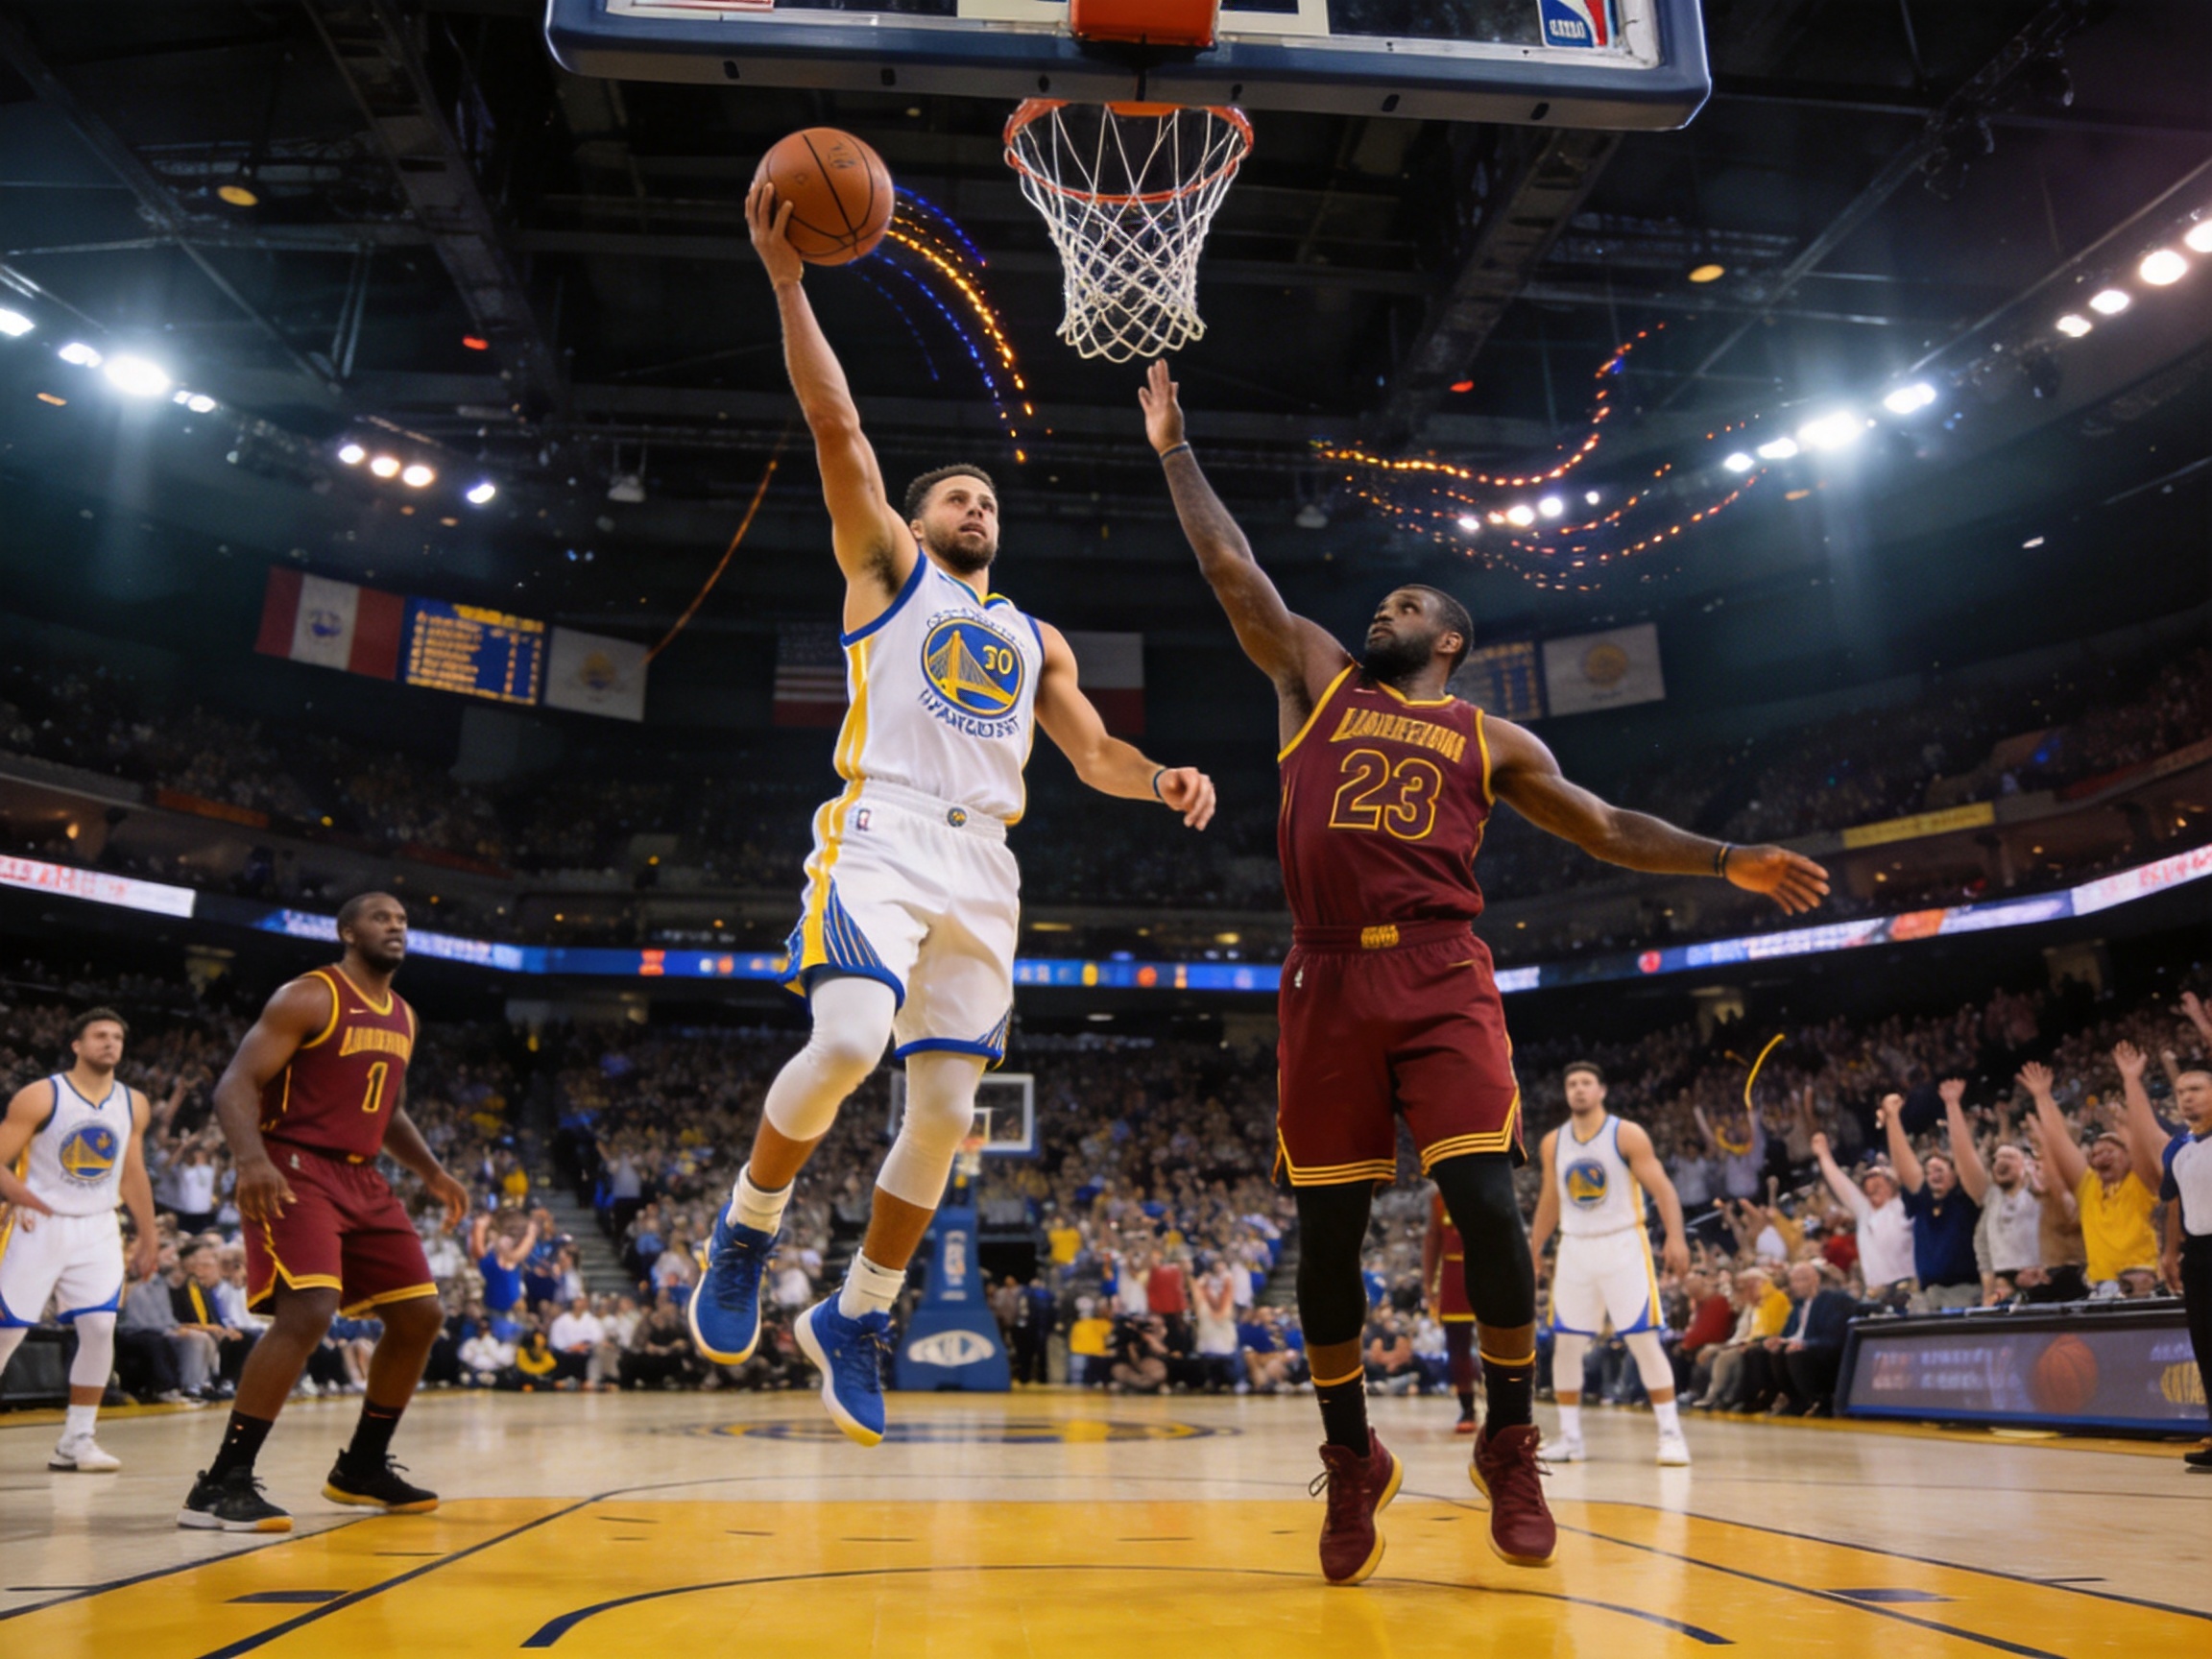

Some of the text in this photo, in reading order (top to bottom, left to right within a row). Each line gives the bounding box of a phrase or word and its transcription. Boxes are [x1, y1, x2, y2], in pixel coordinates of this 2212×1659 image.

[982, 644, 1014, 675] 30
[1328, 748, 1443, 841] 23
[361, 1061, 389, 1114] 1
